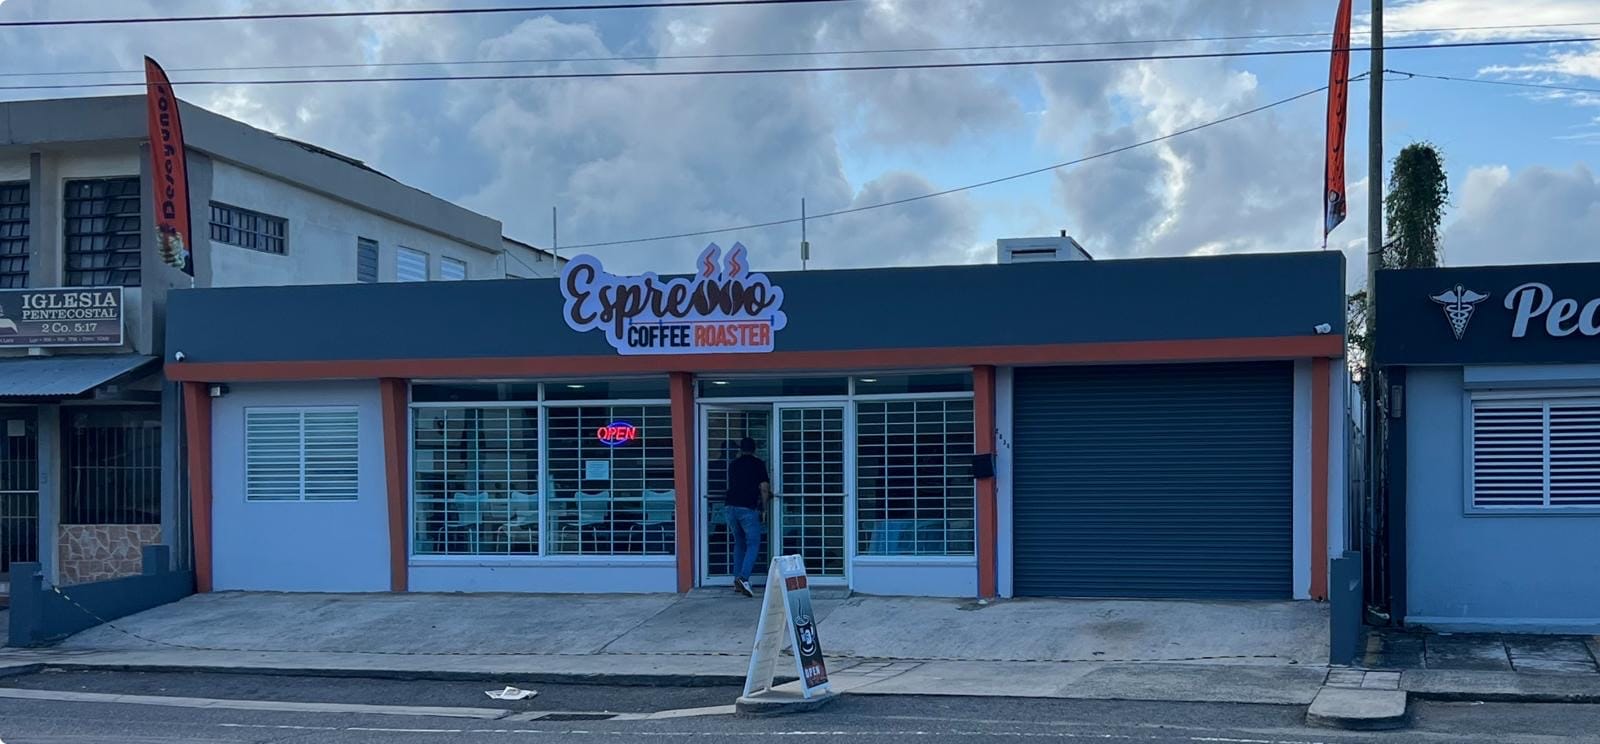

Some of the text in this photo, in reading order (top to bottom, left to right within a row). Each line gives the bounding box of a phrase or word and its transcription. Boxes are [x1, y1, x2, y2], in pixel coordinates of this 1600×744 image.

[22, 292, 117, 309] IGLESIA
[567, 264, 776, 340] Espresso
[22, 308, 117, 320] PENTECOSTAL
[42, 323, 98, 333] 2 Co. 5:17
[628, 323, 770, 348] COFFEE ROASTER
[596, 426, 637, 441] OPEN
[804, 665, 821, 679] OPEN
